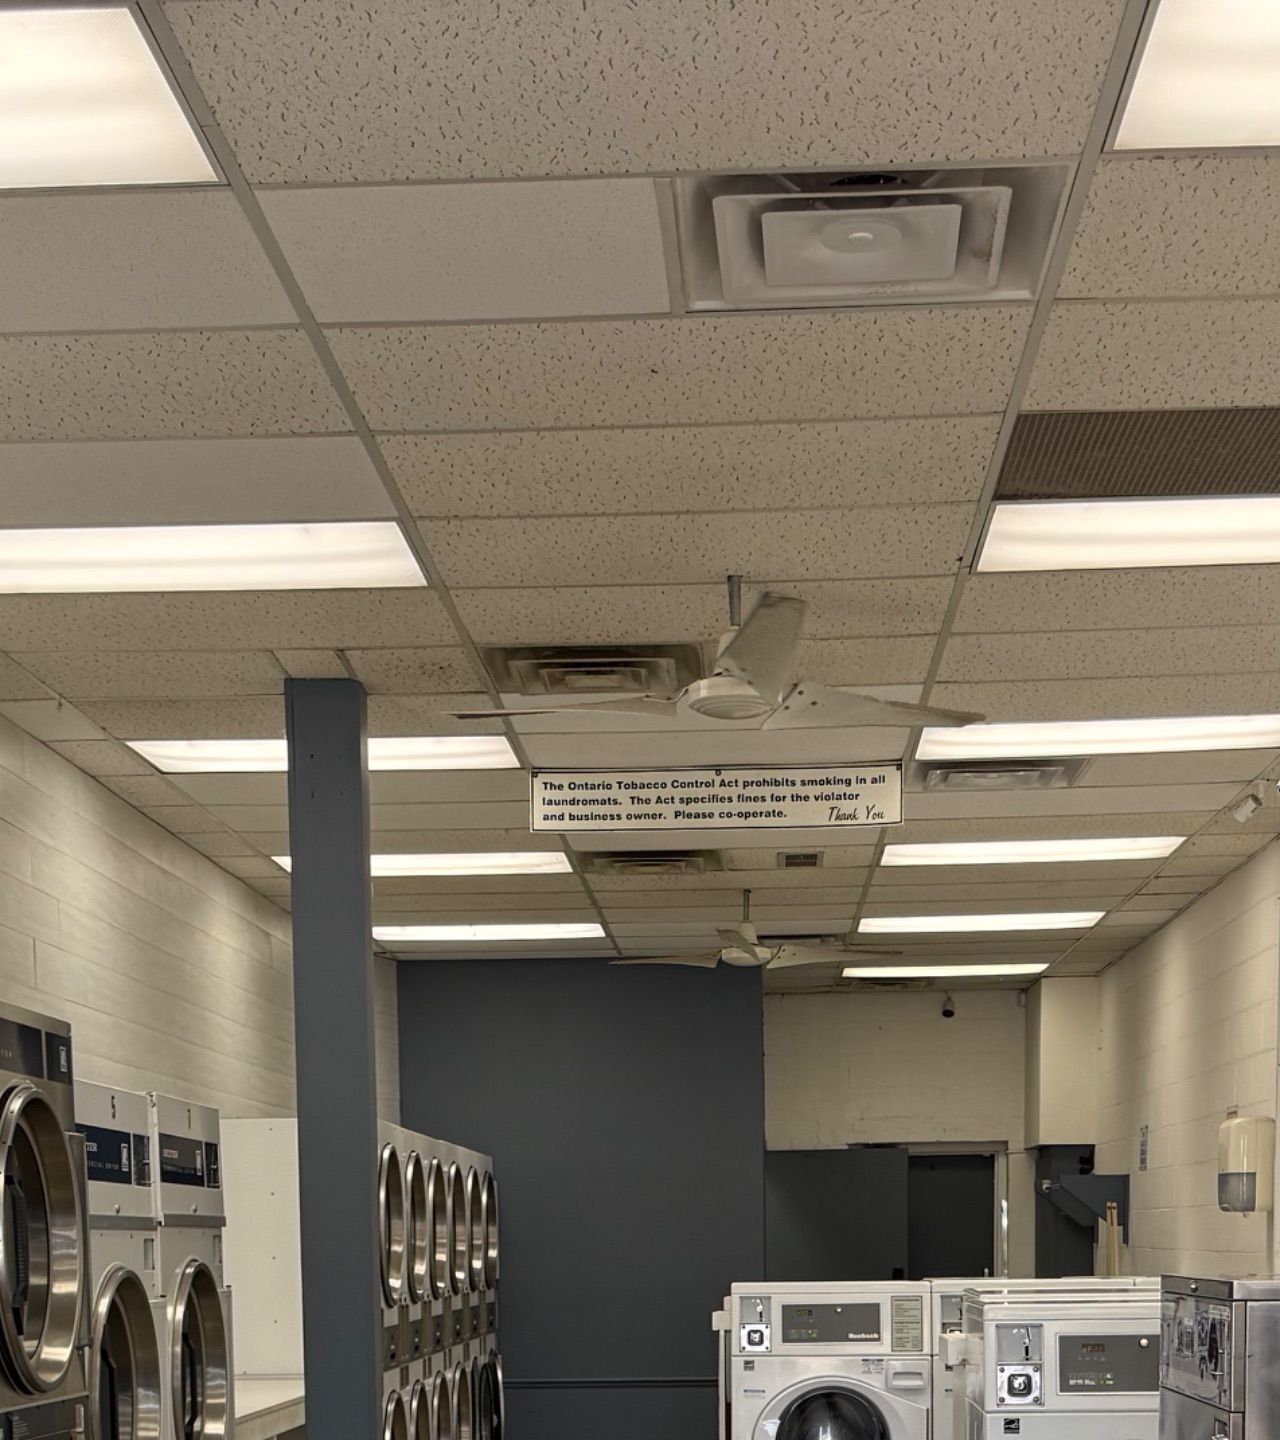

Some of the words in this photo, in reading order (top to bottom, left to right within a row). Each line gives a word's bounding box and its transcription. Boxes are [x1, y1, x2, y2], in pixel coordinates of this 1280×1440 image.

[542, 781, 564, 791] The
[568, 781, 613, 791] Ontario
[616, 780, 667, 790] Tobacco
[671, 779, 715, 789] Control
[719, 779, 739, 788] Act
[742, 777, 797, 790] prohibits
[800, 776, 852, 788] smoking
[856, 776, 867, 785] in
[870, 775, 886, 785] all
[542, 796, 622, 806] laundromats.
[629, 796, 651, 805] The
[655, 796, 675, 805] Act
[678, 794, 733, 807] specifies
[737, 793, 767, 804] fines
[771, 793, 787, 803] for
[790, 793, 810, 803] the
[813, 792, 860, 802] violator
[542, 812, 565, 822] and
[568, 811, 622, 822] business
[626, 812, 667, 821] owner.
[674, 810, 715, 820] Please
[718, 809, 788, 821] co-operate.
[828, 806, 860, 822] Thank
[865, 804, 886, 821] You
